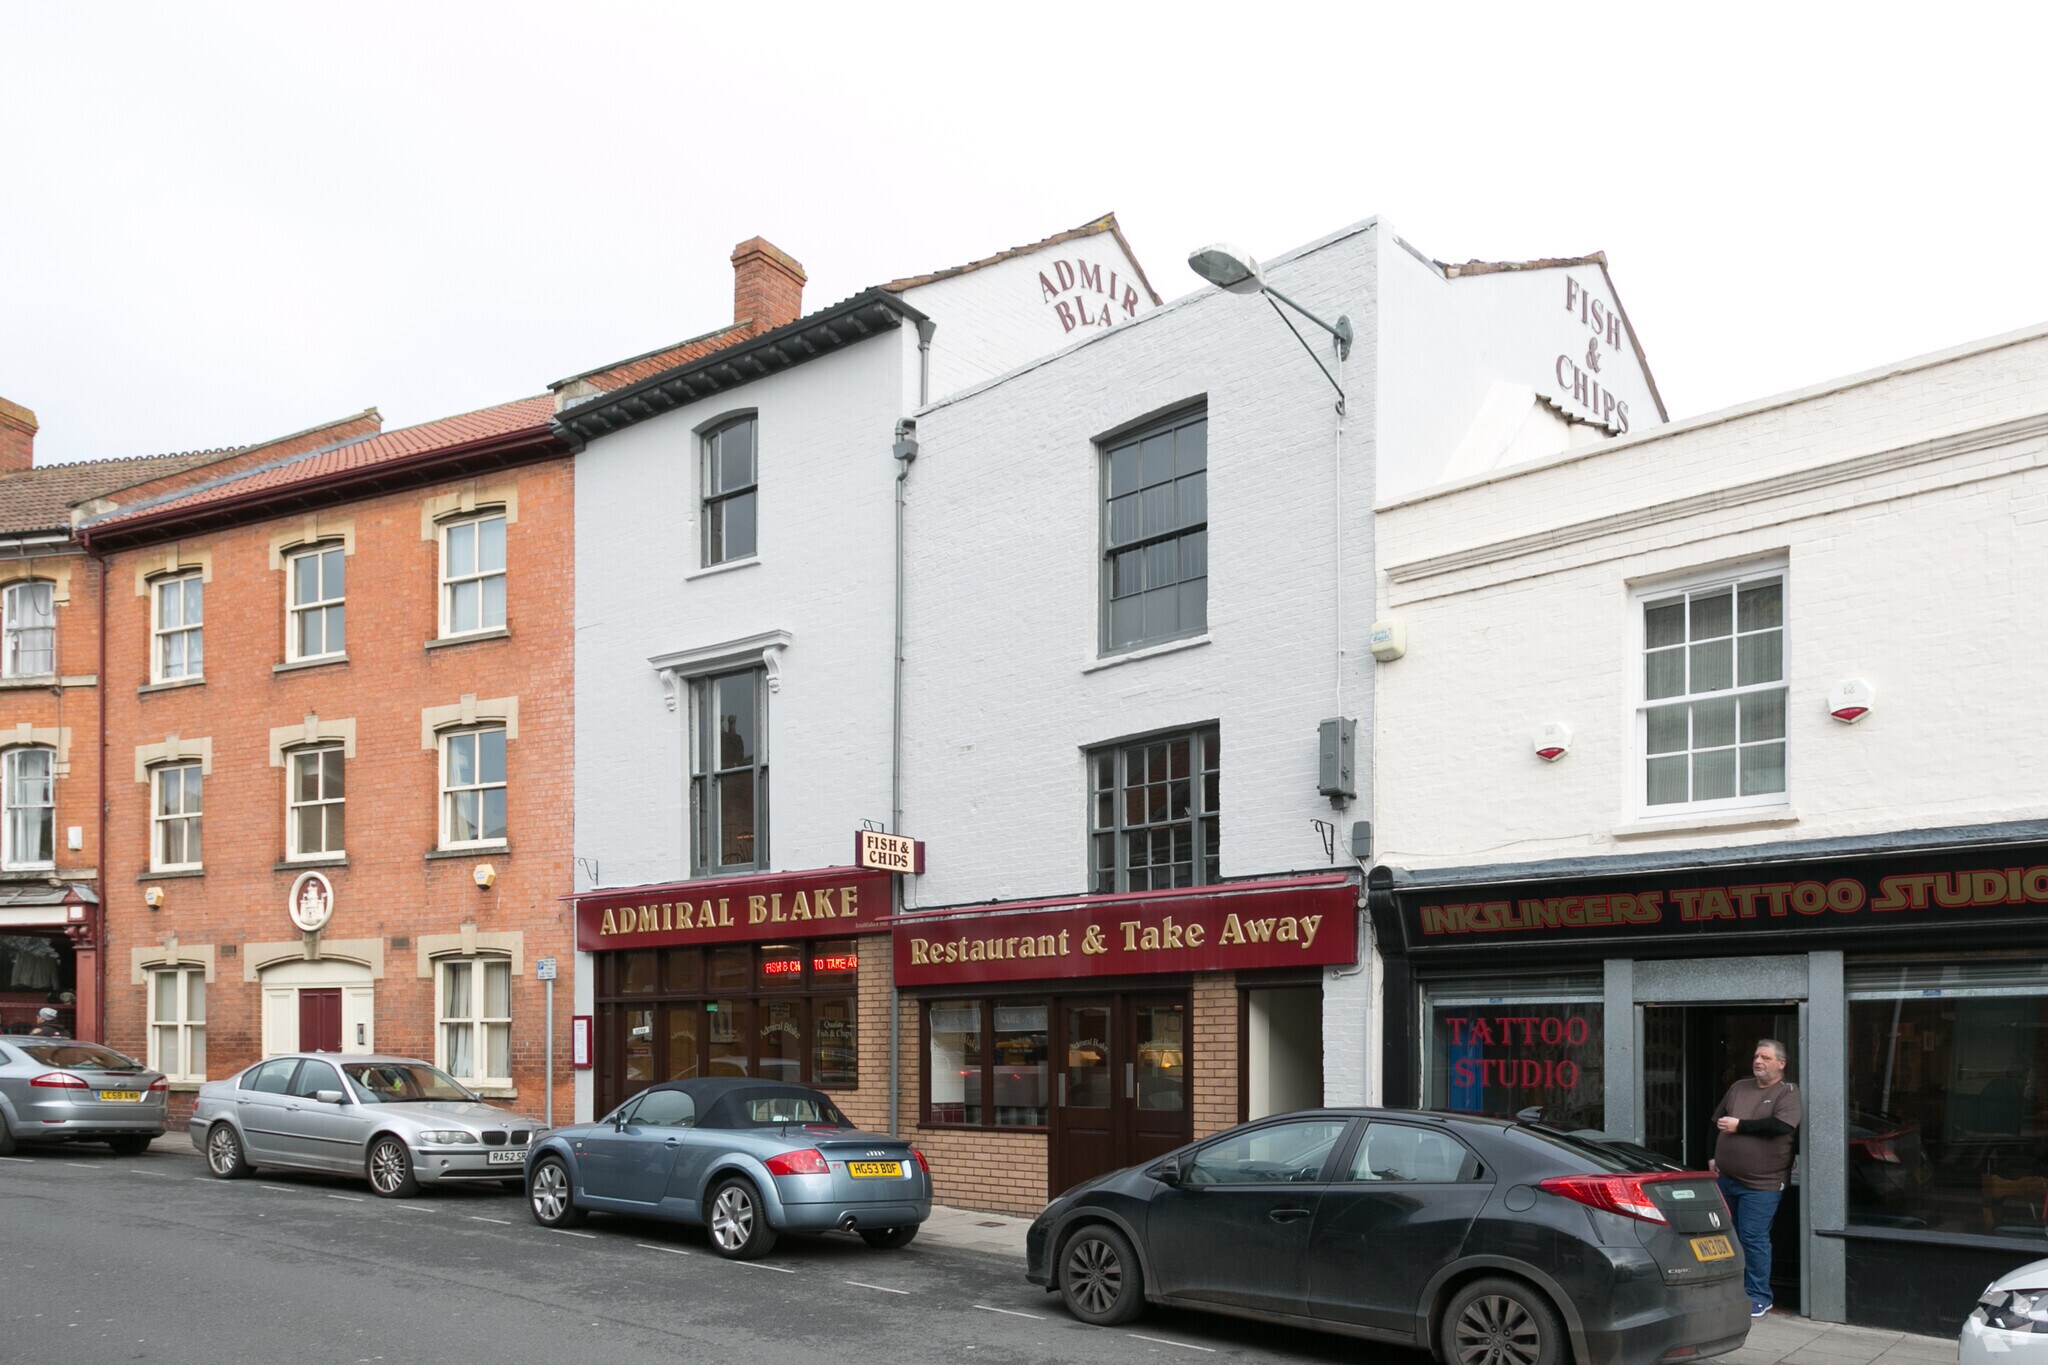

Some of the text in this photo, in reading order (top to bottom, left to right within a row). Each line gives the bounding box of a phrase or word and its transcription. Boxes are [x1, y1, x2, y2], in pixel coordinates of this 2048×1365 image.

[1053, 295, 1113, 334] BLA
[1565, 274, 1622, 352] FISH
[1585, 336, 1602, 374] &
[1555, 354, 1629, 435] CHIPS
[867, 836, 910, 854] FISH &
[869, 850, 908, 868] CHIPS
[600, 886, 858, 936] ADMIRAL BLAKE
[1419, 890, 1664, 936] INKSLINGERS
[1669, 877, 1867, 923] TATTOO
[910, 913, 1323, 966] Restaurant & Take Away
[765, 961, 782, 974] FISH
[782, 961, 789, 972] &
[813, 959, 824, 970] TO
[826, 958, 846, 970] TAKE
[824, 1020, 845, 1029] Quality
[1446, 1016, 1589, 1047] TATTOO
[1454, 1056, 1579, 1089] STUDIO
[492, 1152, 516, 1162] RA52
[853, 1163, 897, 1174] HG53 BDF
